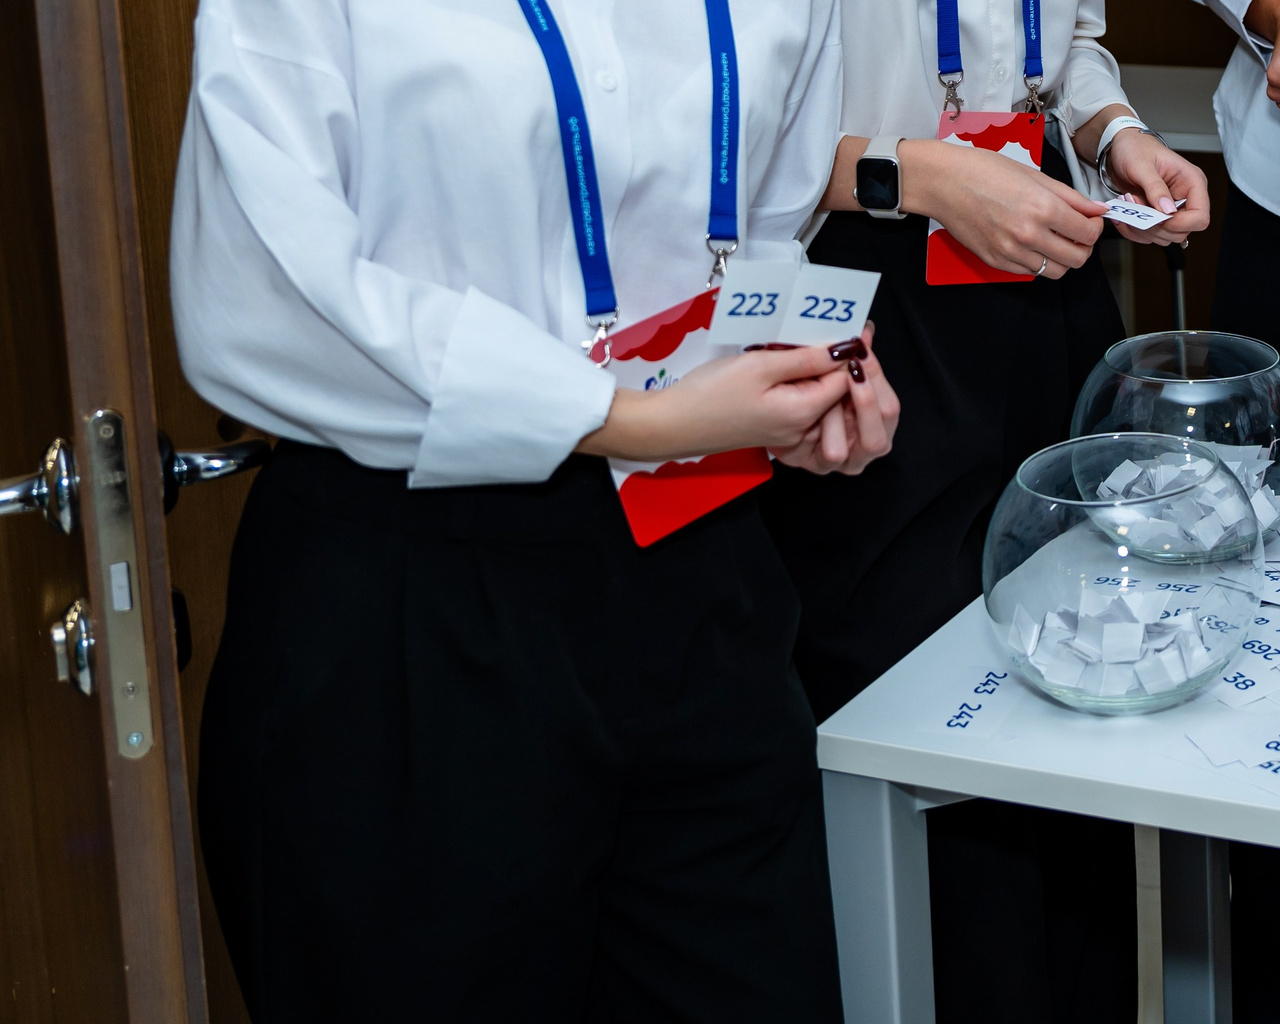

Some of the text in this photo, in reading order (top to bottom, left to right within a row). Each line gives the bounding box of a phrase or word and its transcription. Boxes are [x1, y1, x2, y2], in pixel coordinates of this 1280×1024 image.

[719, 52, 731, 185] мамапредприниматель.рф
[567, 115, 597, 257] мамапредприниматель.рф
[727, 293, 779, 317] 223
[800, 295, 857, 322] 223
[1155, 582, 1202, 593] 256
[974, 671, 1008, 695] 243
[1223, 671, 1256, 691] 38
[946, 702, 982, 728] 243
